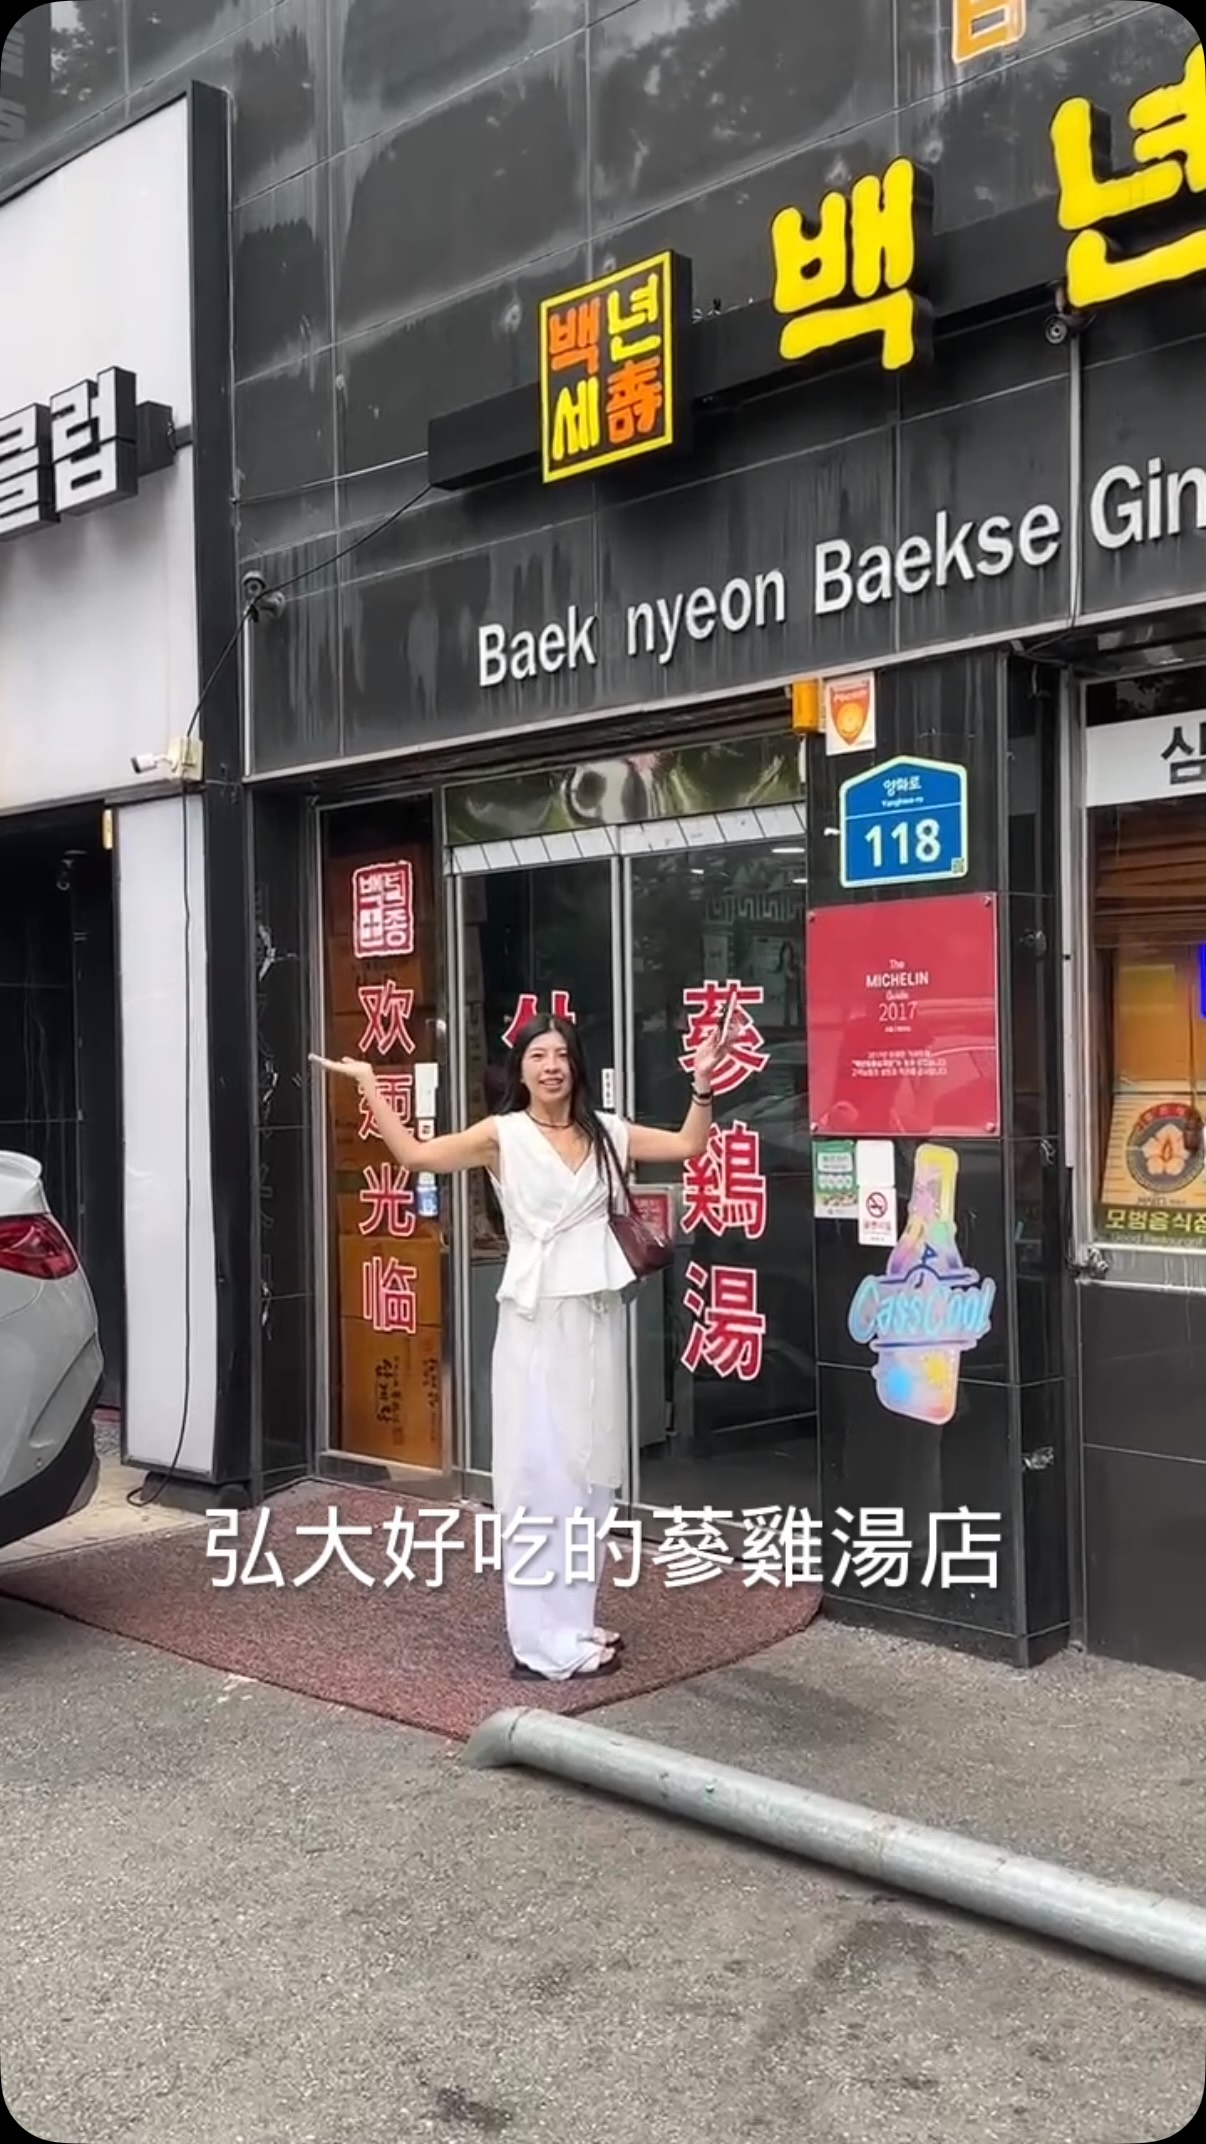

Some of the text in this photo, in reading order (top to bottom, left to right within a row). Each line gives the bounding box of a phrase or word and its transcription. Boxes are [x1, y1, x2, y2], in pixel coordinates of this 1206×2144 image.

[478, 456, 1206, 688] Baek nyeon Baekse Gin
[883, 776, 922, 797] 양화로
[865, 819, 941, 867] 118
[889, 959, 905, 969] The
[866, 971, 928, 988] MICHELIN
[879, 1001, 918, 1021] 2017
